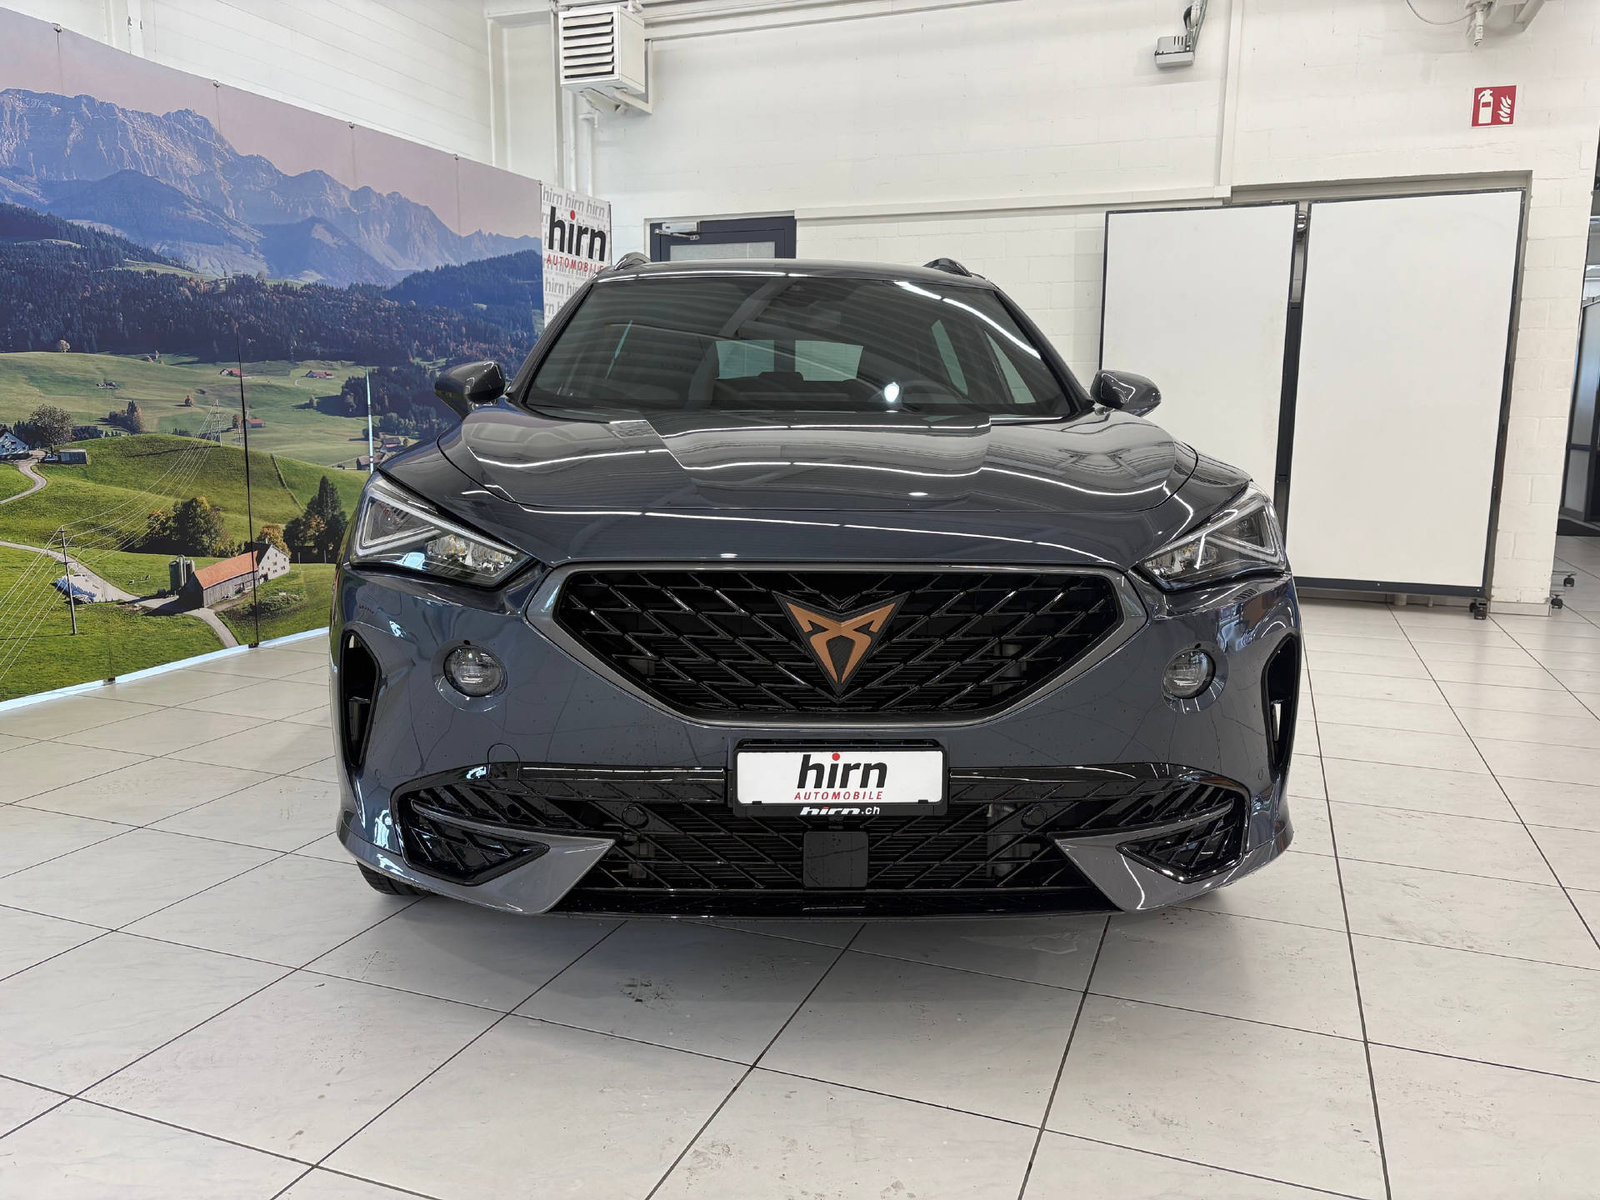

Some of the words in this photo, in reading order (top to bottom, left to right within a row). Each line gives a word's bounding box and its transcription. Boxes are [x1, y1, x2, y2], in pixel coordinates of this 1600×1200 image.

[548, 205, 607, 262] hirn
[797, 752, 888, 789] hirn
[794, 791, 883, 801] AUTOMOBILE
[800, 806, 880, 815] hirn.ch
